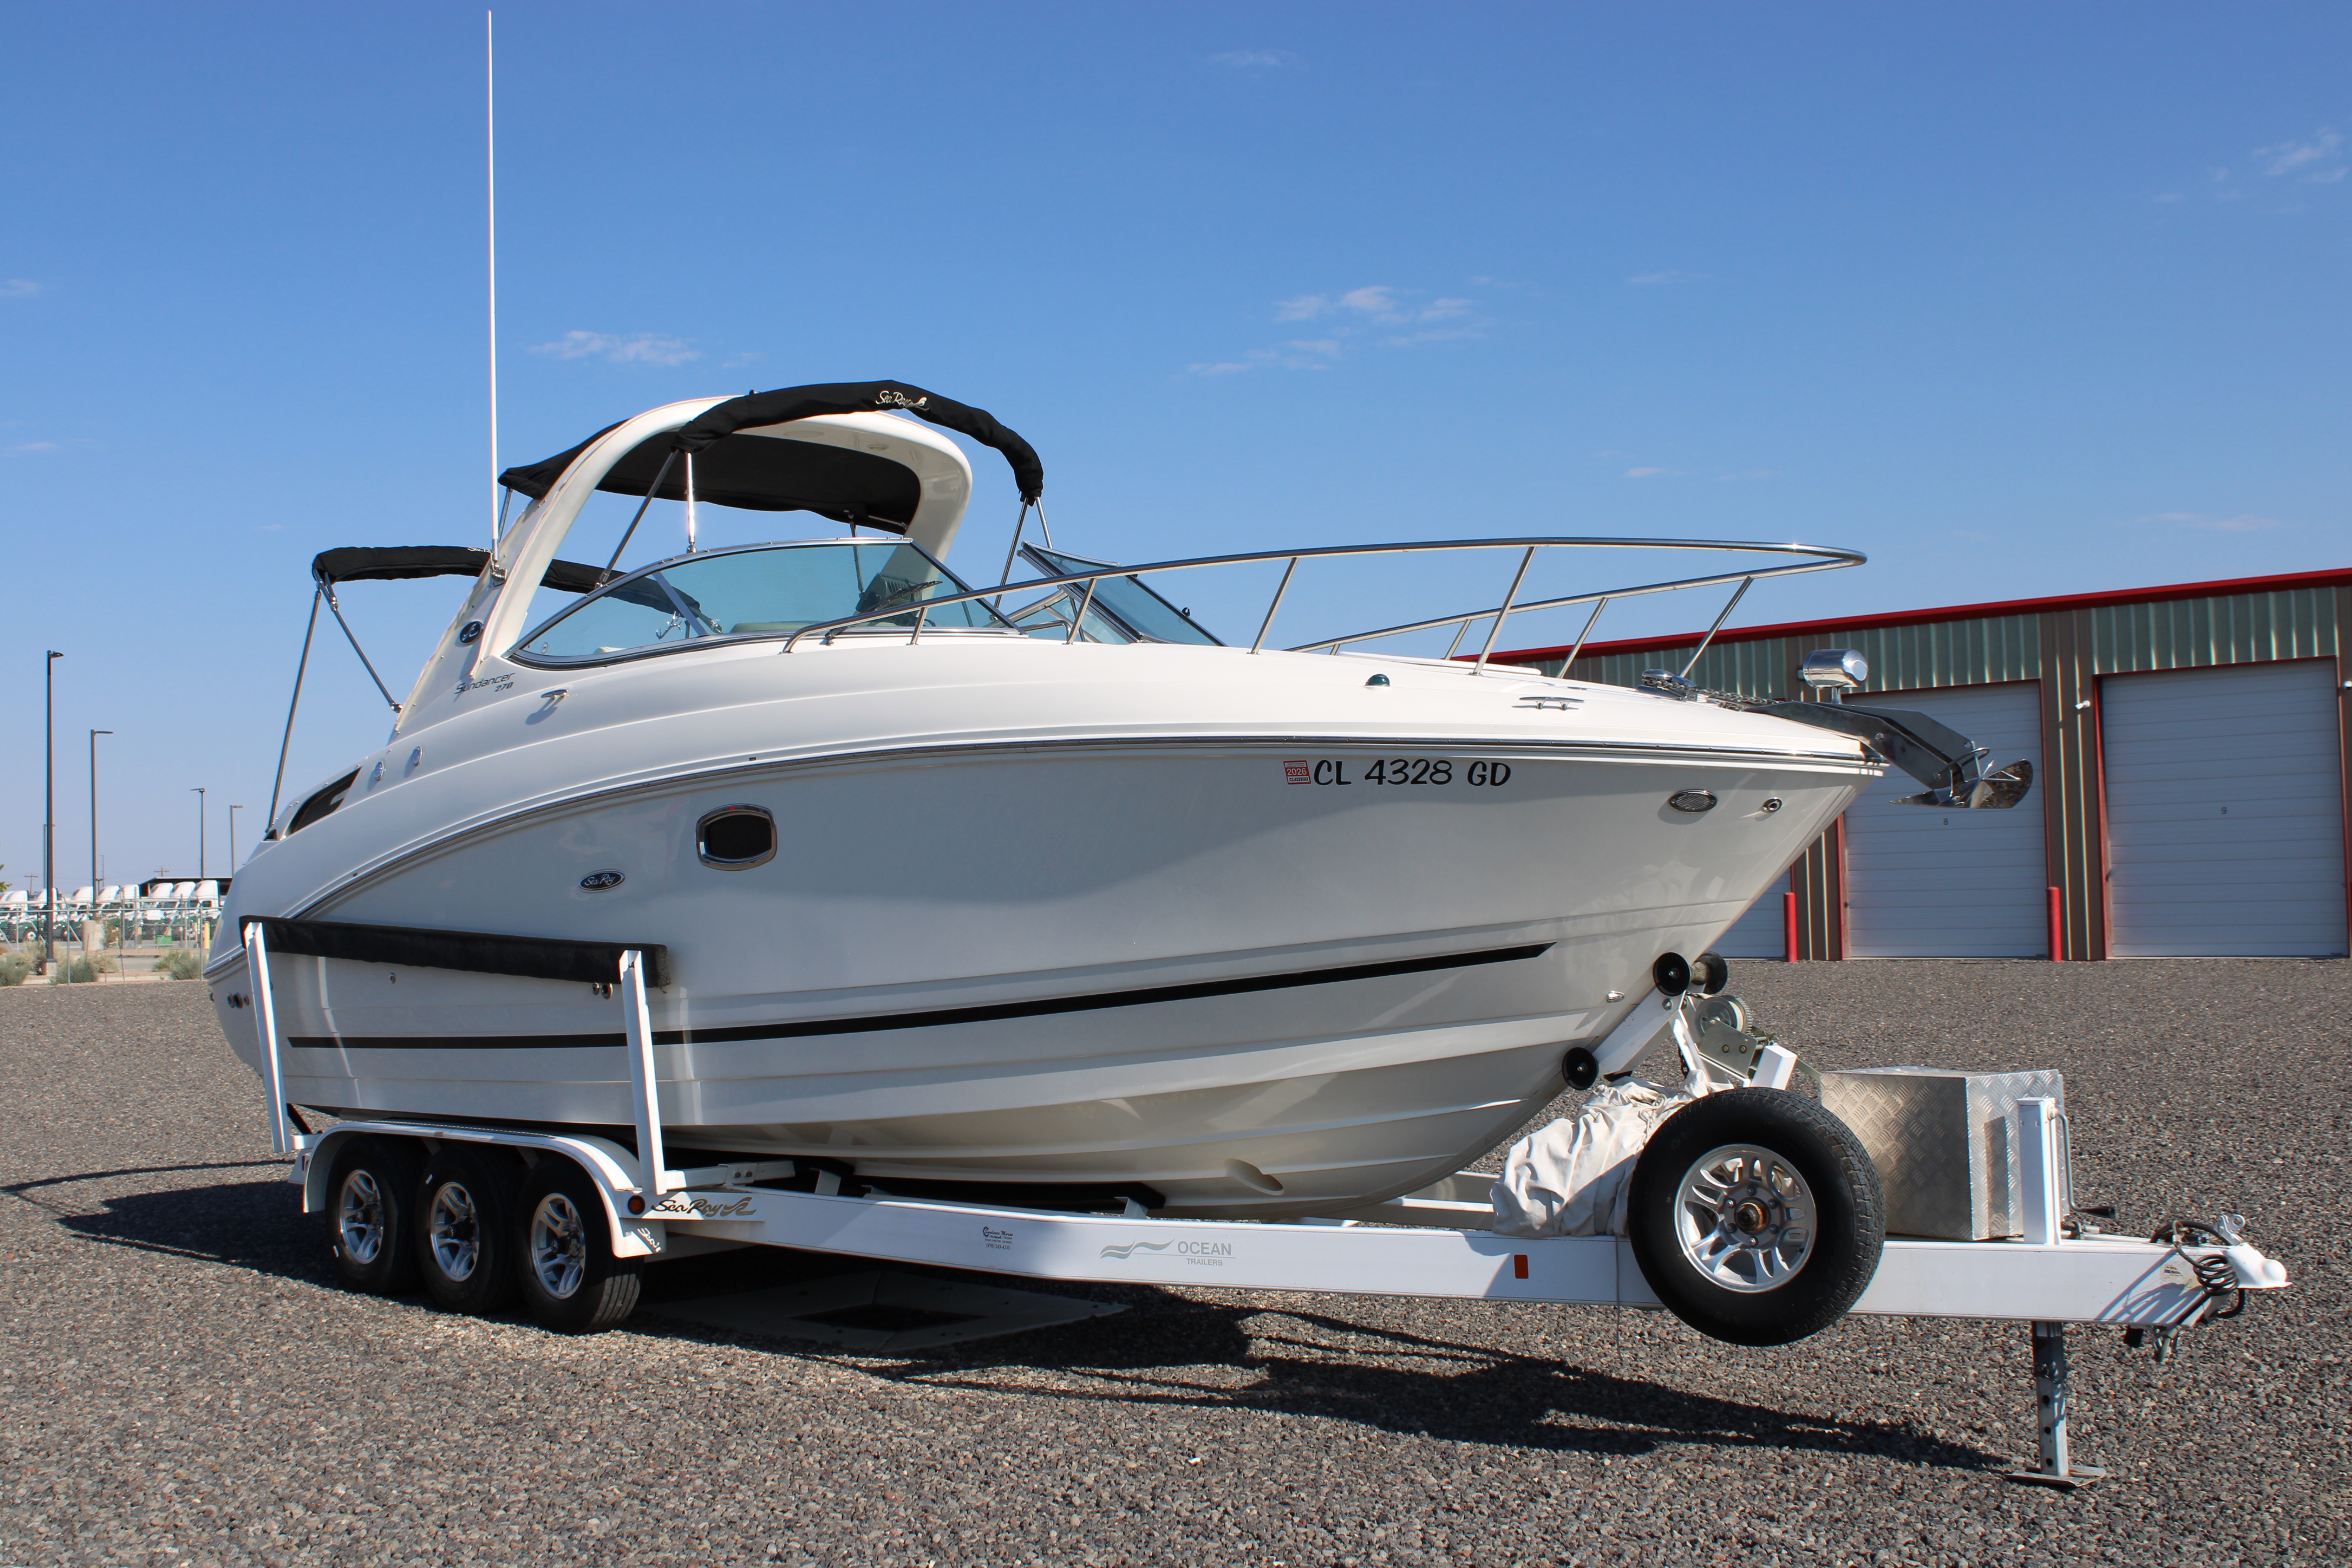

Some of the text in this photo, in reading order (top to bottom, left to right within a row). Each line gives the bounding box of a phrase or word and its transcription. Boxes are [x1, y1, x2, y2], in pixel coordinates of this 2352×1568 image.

[875, 390, 912, 407] Sea Ray
[454, 672, 515, 694] Sundancer
[494, 681, 514, 692] 270
[1314, 759, 1511, 786] CL 4328 GD
[2221, 806, 2227, 815] 9
[584, 873, 616, 886] Sea Ray
[651, 1198, 724, 1217] Sea Ray
[1177, 1240, 1232, 1256] OCEAN
[1186, 1257, 1223, 1266] TRAILERS
